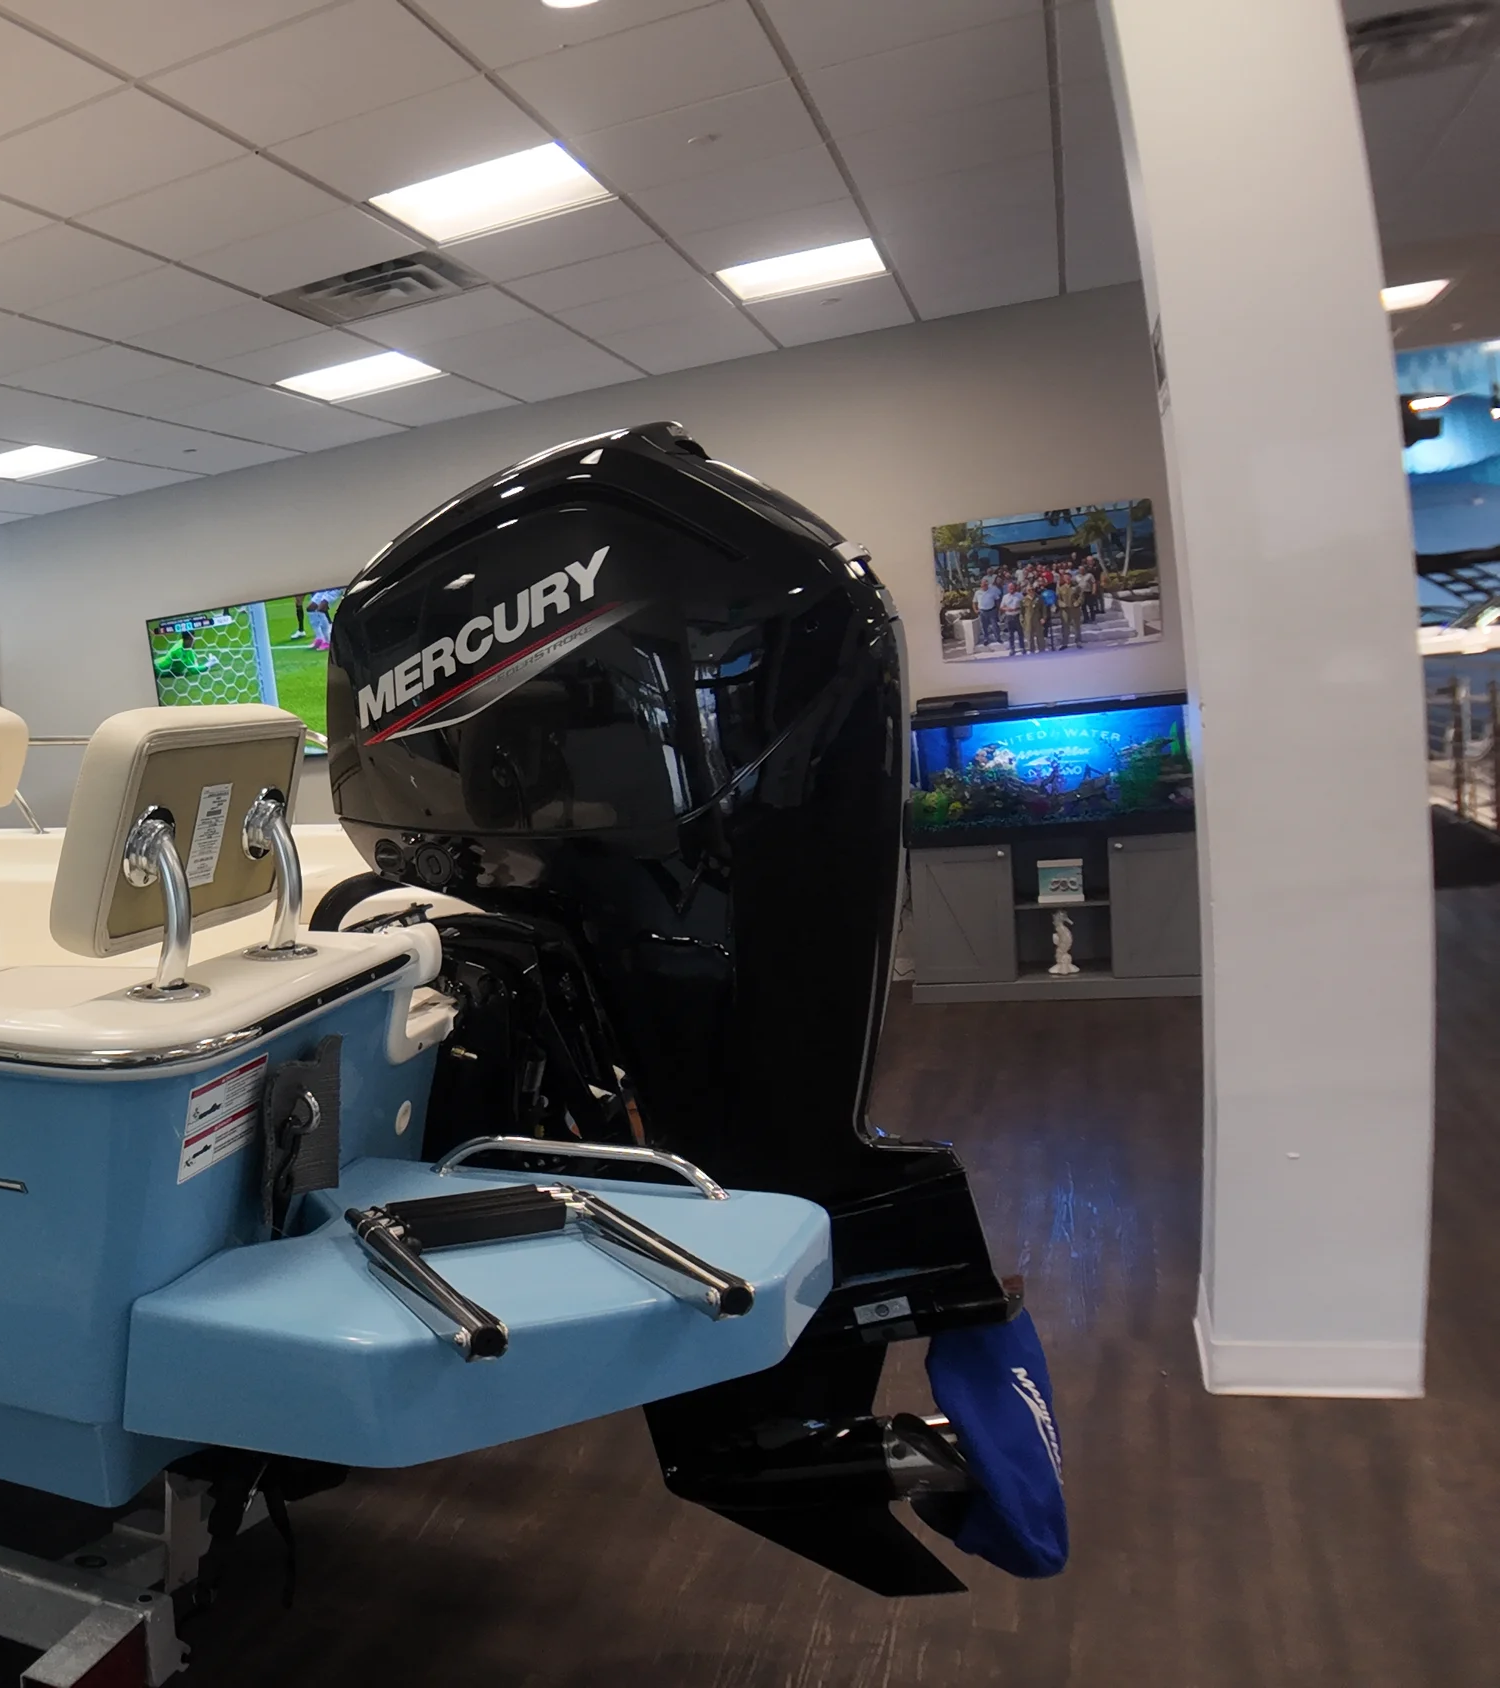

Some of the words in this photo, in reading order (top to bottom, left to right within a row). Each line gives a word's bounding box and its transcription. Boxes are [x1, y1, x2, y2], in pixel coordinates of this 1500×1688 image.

[357, 546, 610, 729] MERCURY
[493, 622, 594, 682] FOURSTROKE
[998, 730, 1047, 747] NITED
